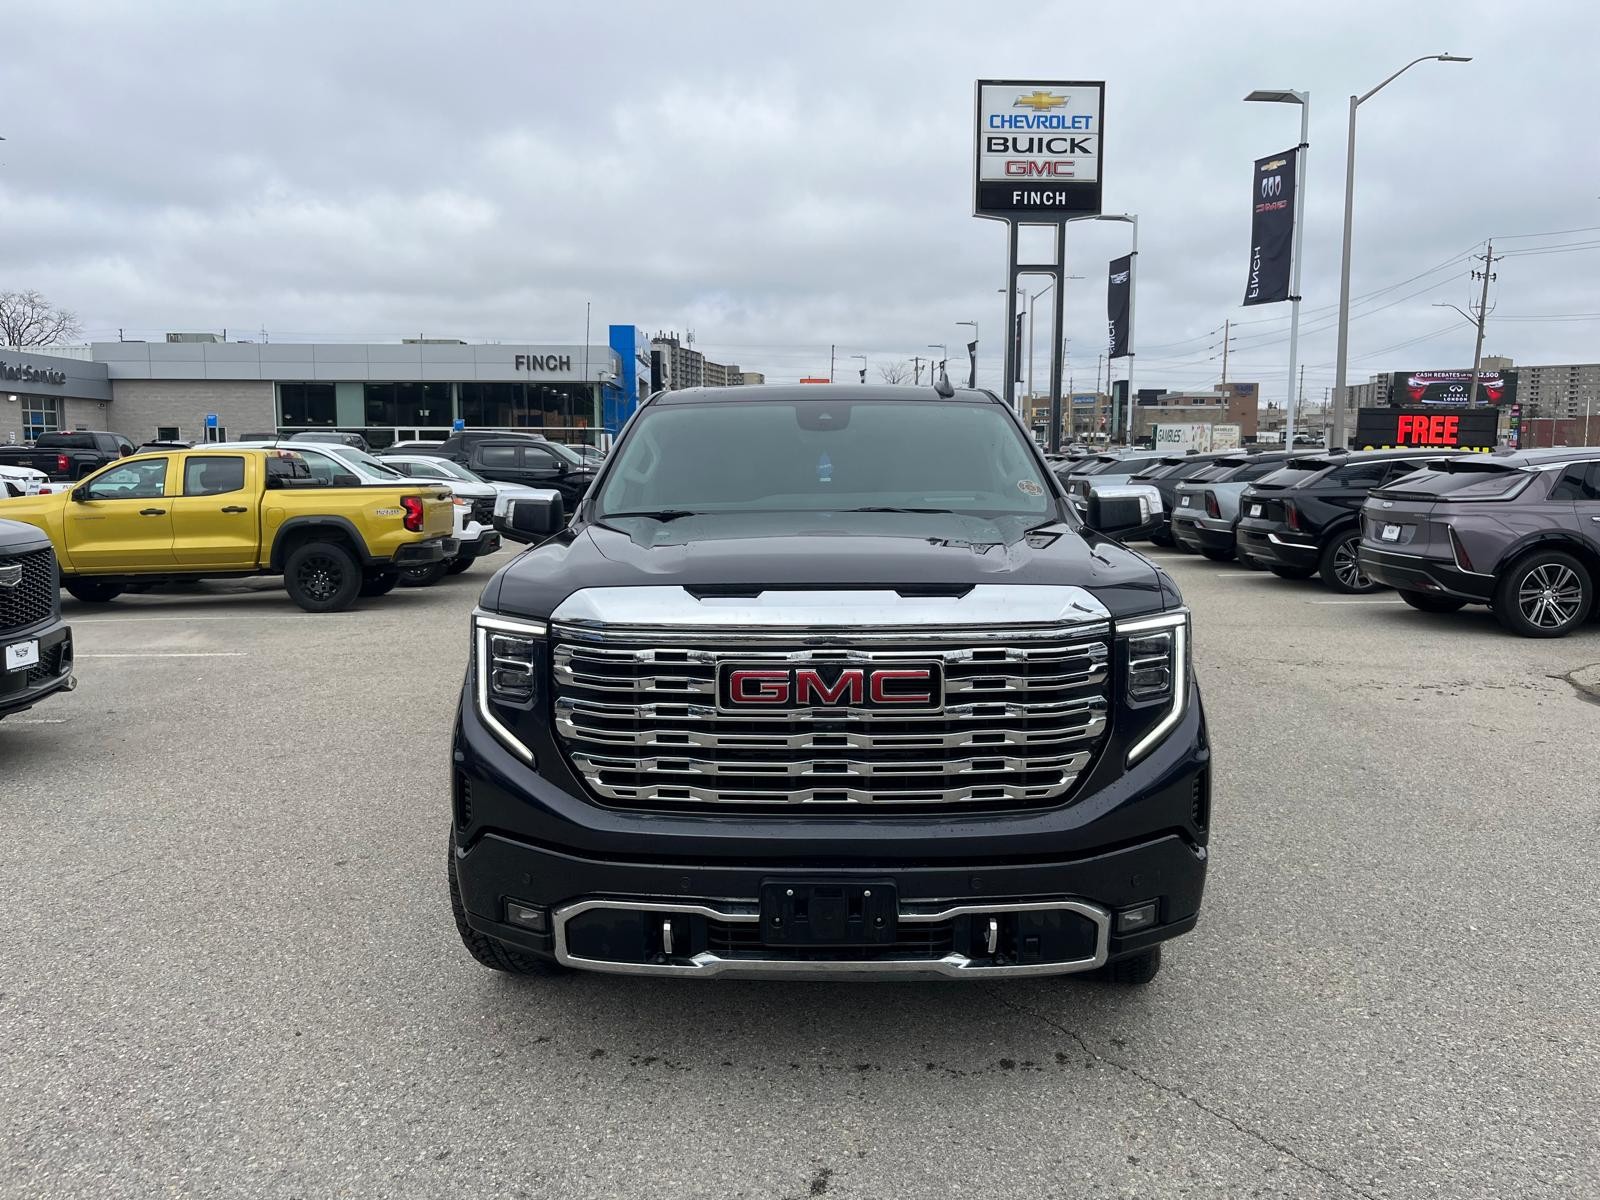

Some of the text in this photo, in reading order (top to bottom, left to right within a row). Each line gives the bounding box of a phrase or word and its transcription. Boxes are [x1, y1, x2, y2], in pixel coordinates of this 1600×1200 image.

[989, 114, 1093, 130] CHEVROLET
[986, 136, 1093, 154] BUICK
[1005, 160, 1075, 177] GMC
[1012, 191, 1066, 205] FINCH
[515, 354, 571, 371] FINCH
[22, 364, 66, 385] Service
[1157, 429, 1182, 443] GAMBLES
[1396, 415, 1459, 444] FREE
[730, 669, 931, 705] GMC
